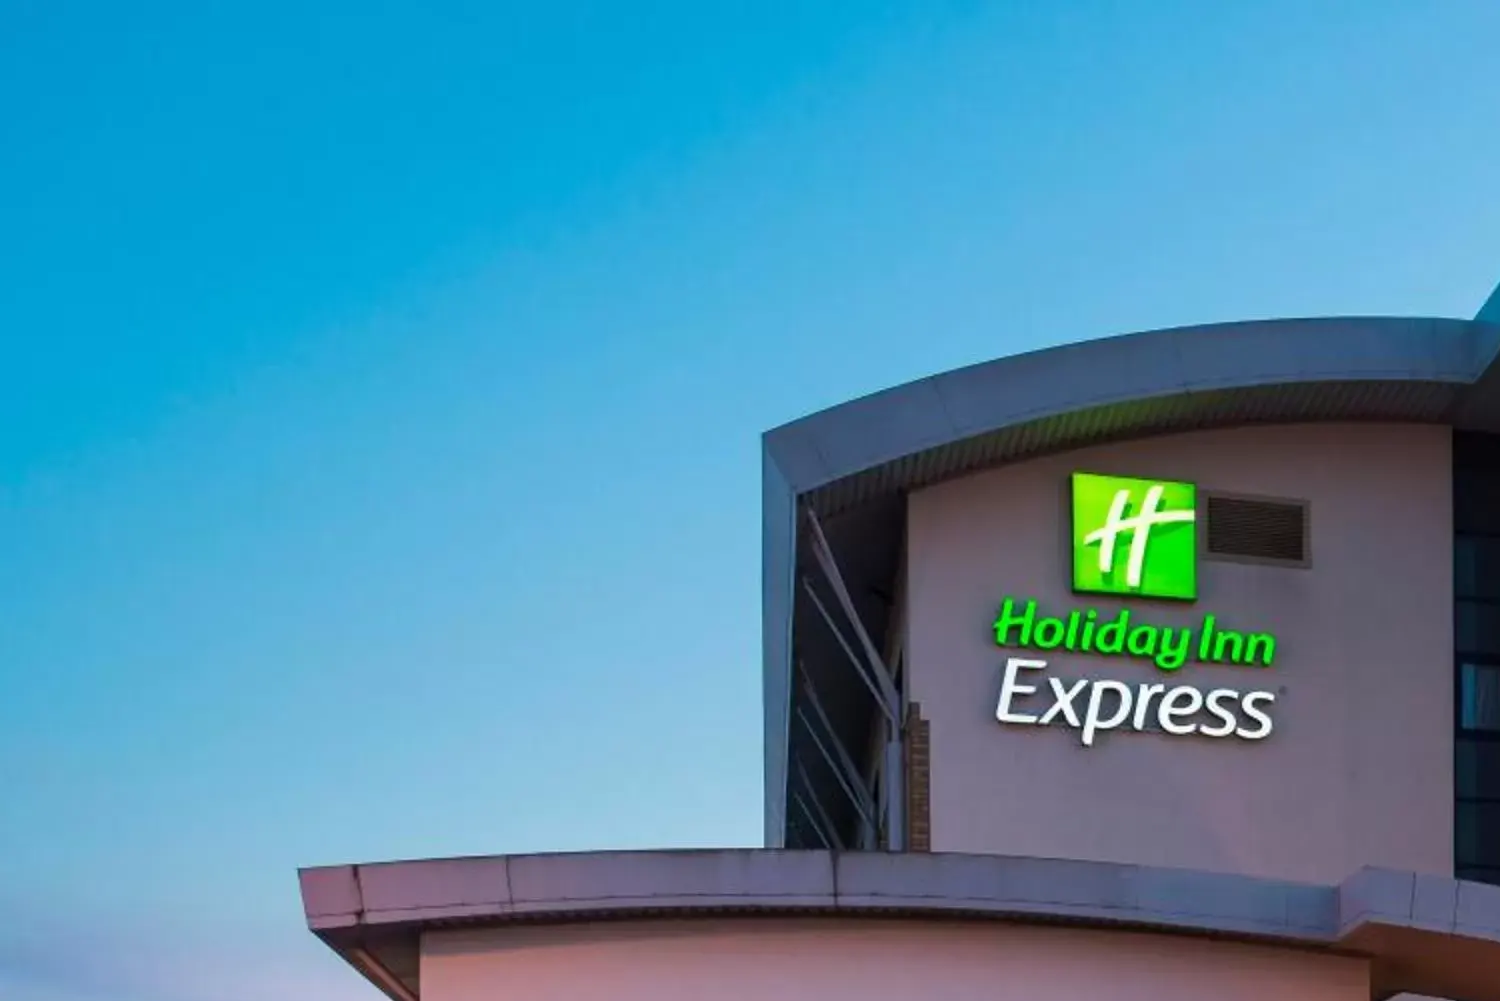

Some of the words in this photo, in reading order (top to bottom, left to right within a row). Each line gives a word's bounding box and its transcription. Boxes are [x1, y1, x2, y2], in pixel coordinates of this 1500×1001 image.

[1083, 485, 1195, 587] H
[993, 598, 1191, 670] Holiday
[1199, 614, 1277, 665] Inn
[995, 657, 1276, 746] Express
